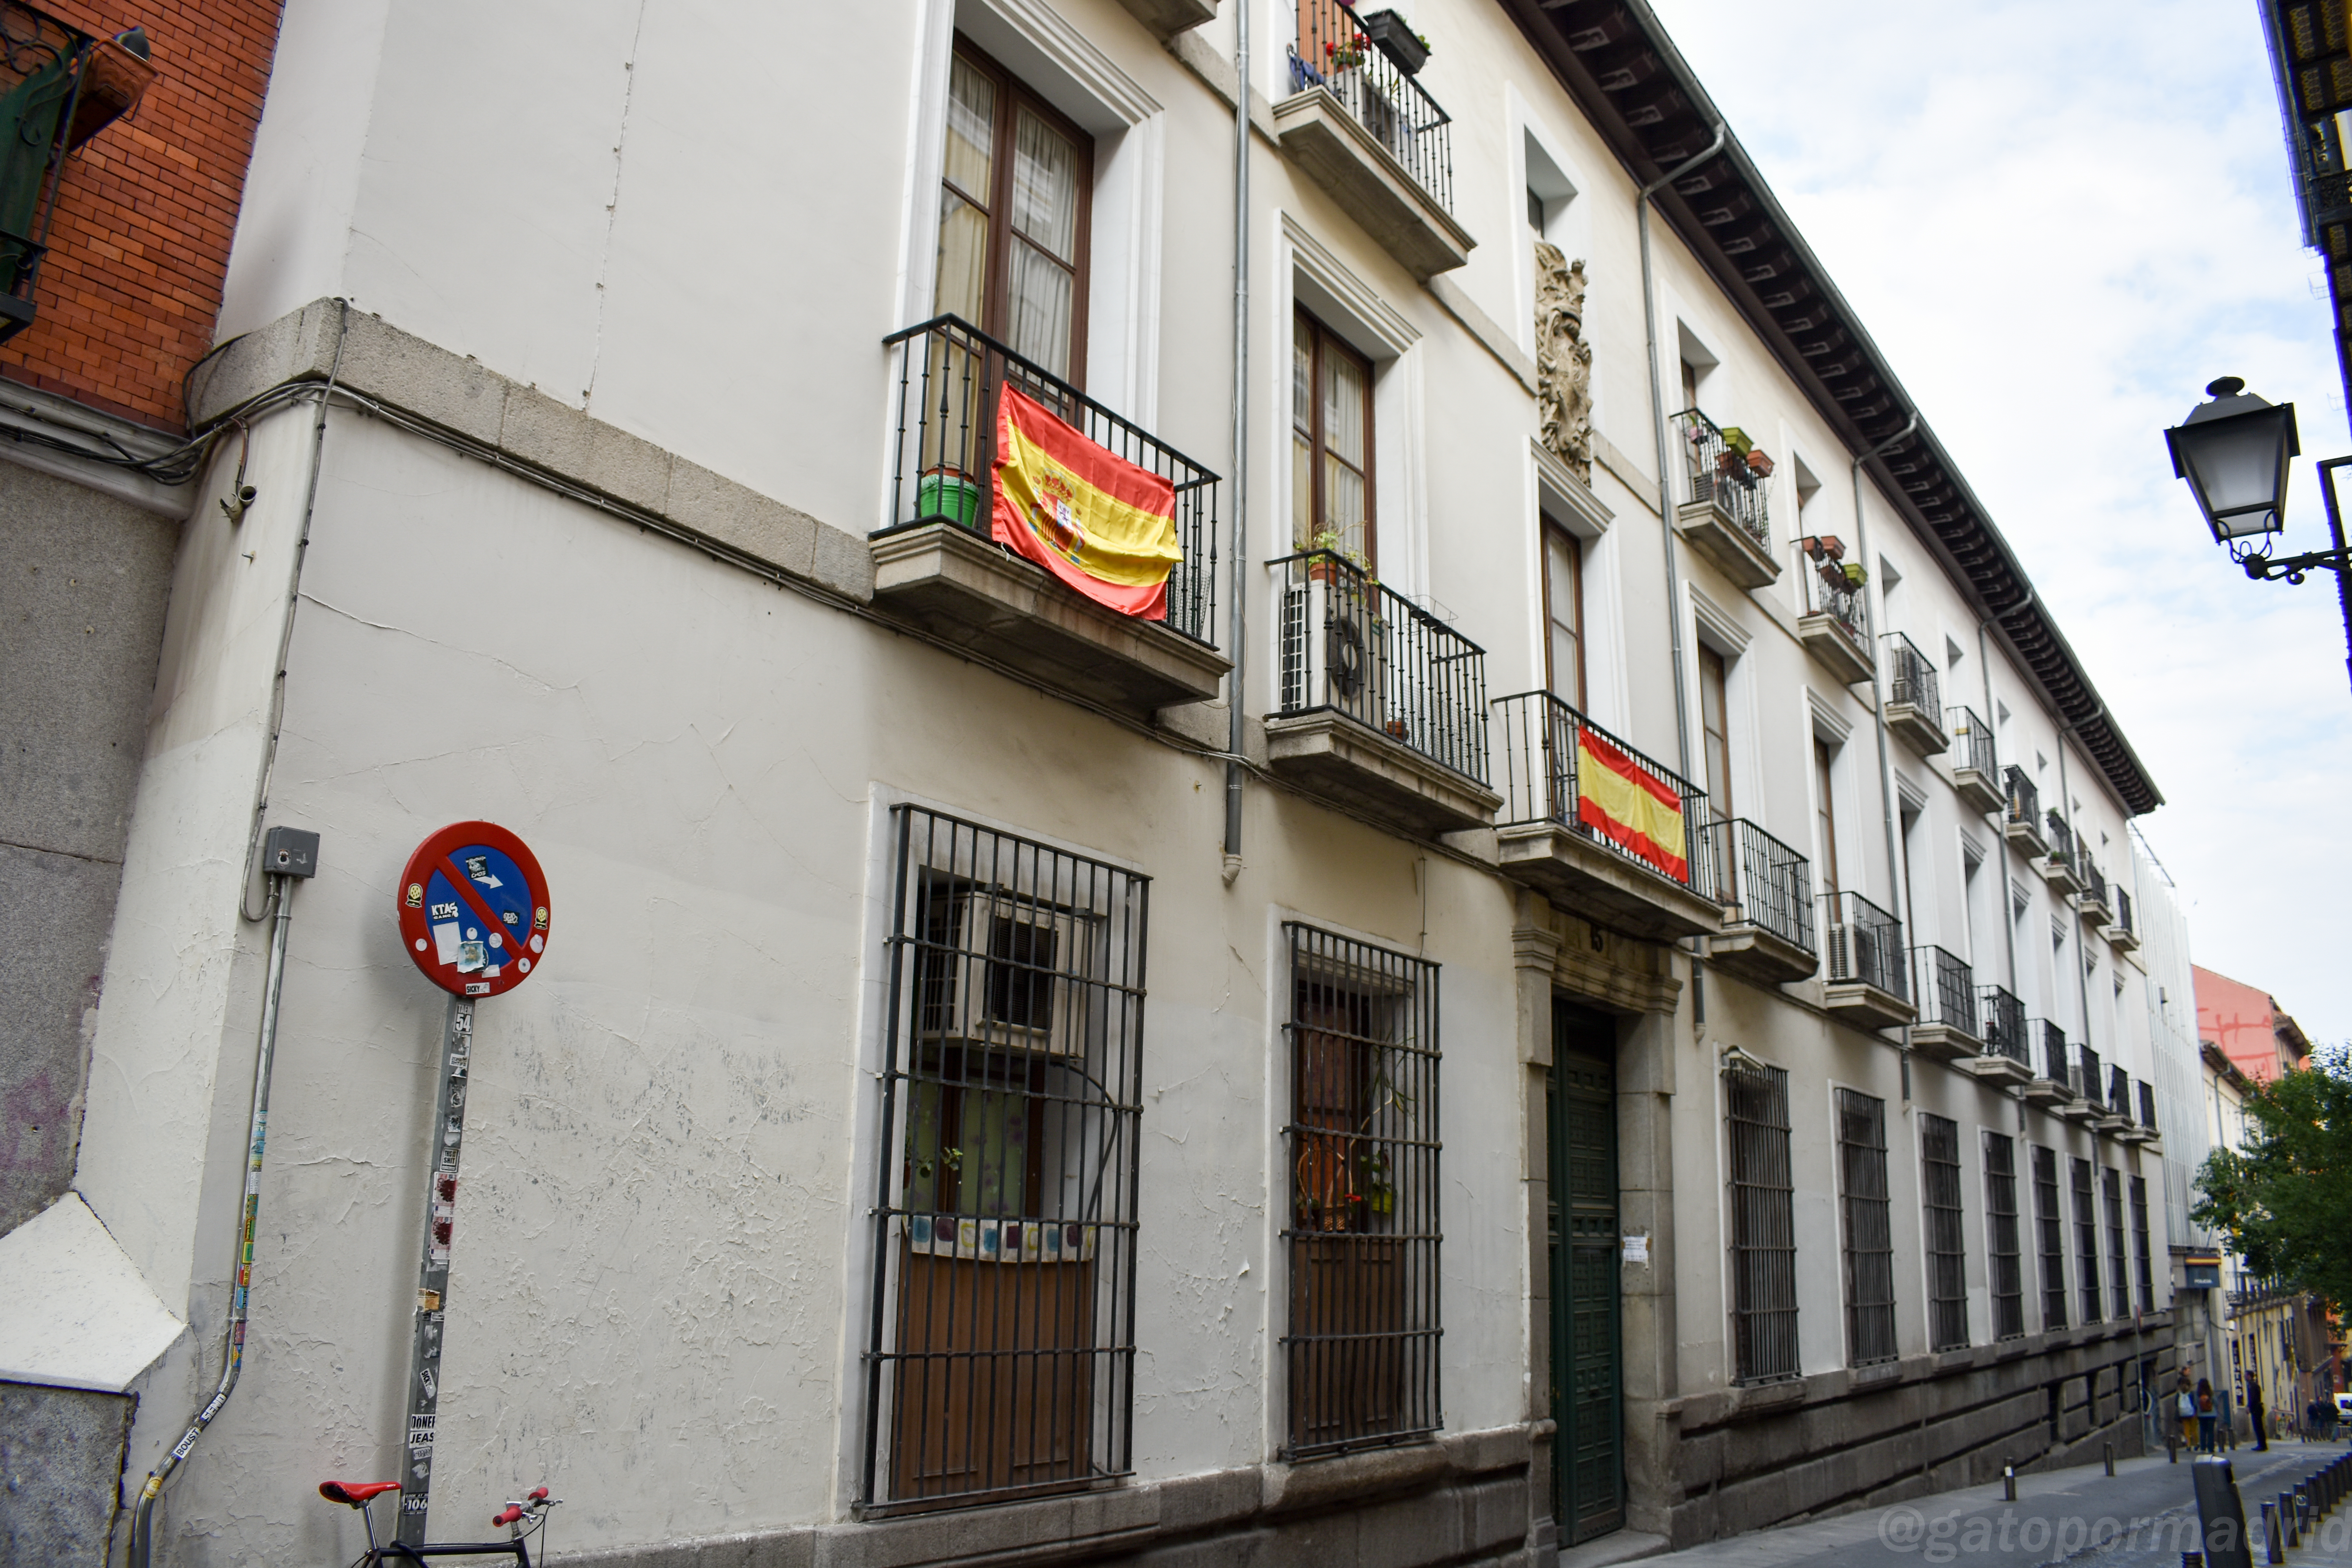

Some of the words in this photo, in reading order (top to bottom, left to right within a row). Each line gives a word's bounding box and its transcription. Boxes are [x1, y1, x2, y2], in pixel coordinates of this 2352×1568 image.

[431, 902, 458, 916] KTAS
[457, 1004, 473, 1015] TAEM
[456, 1013, 471, 1032] 54
[201, 1393, 227, 1423] SEND
[176, 1428, 199, 1456] BOUST
[407, 1498, 428, 1511] 106
